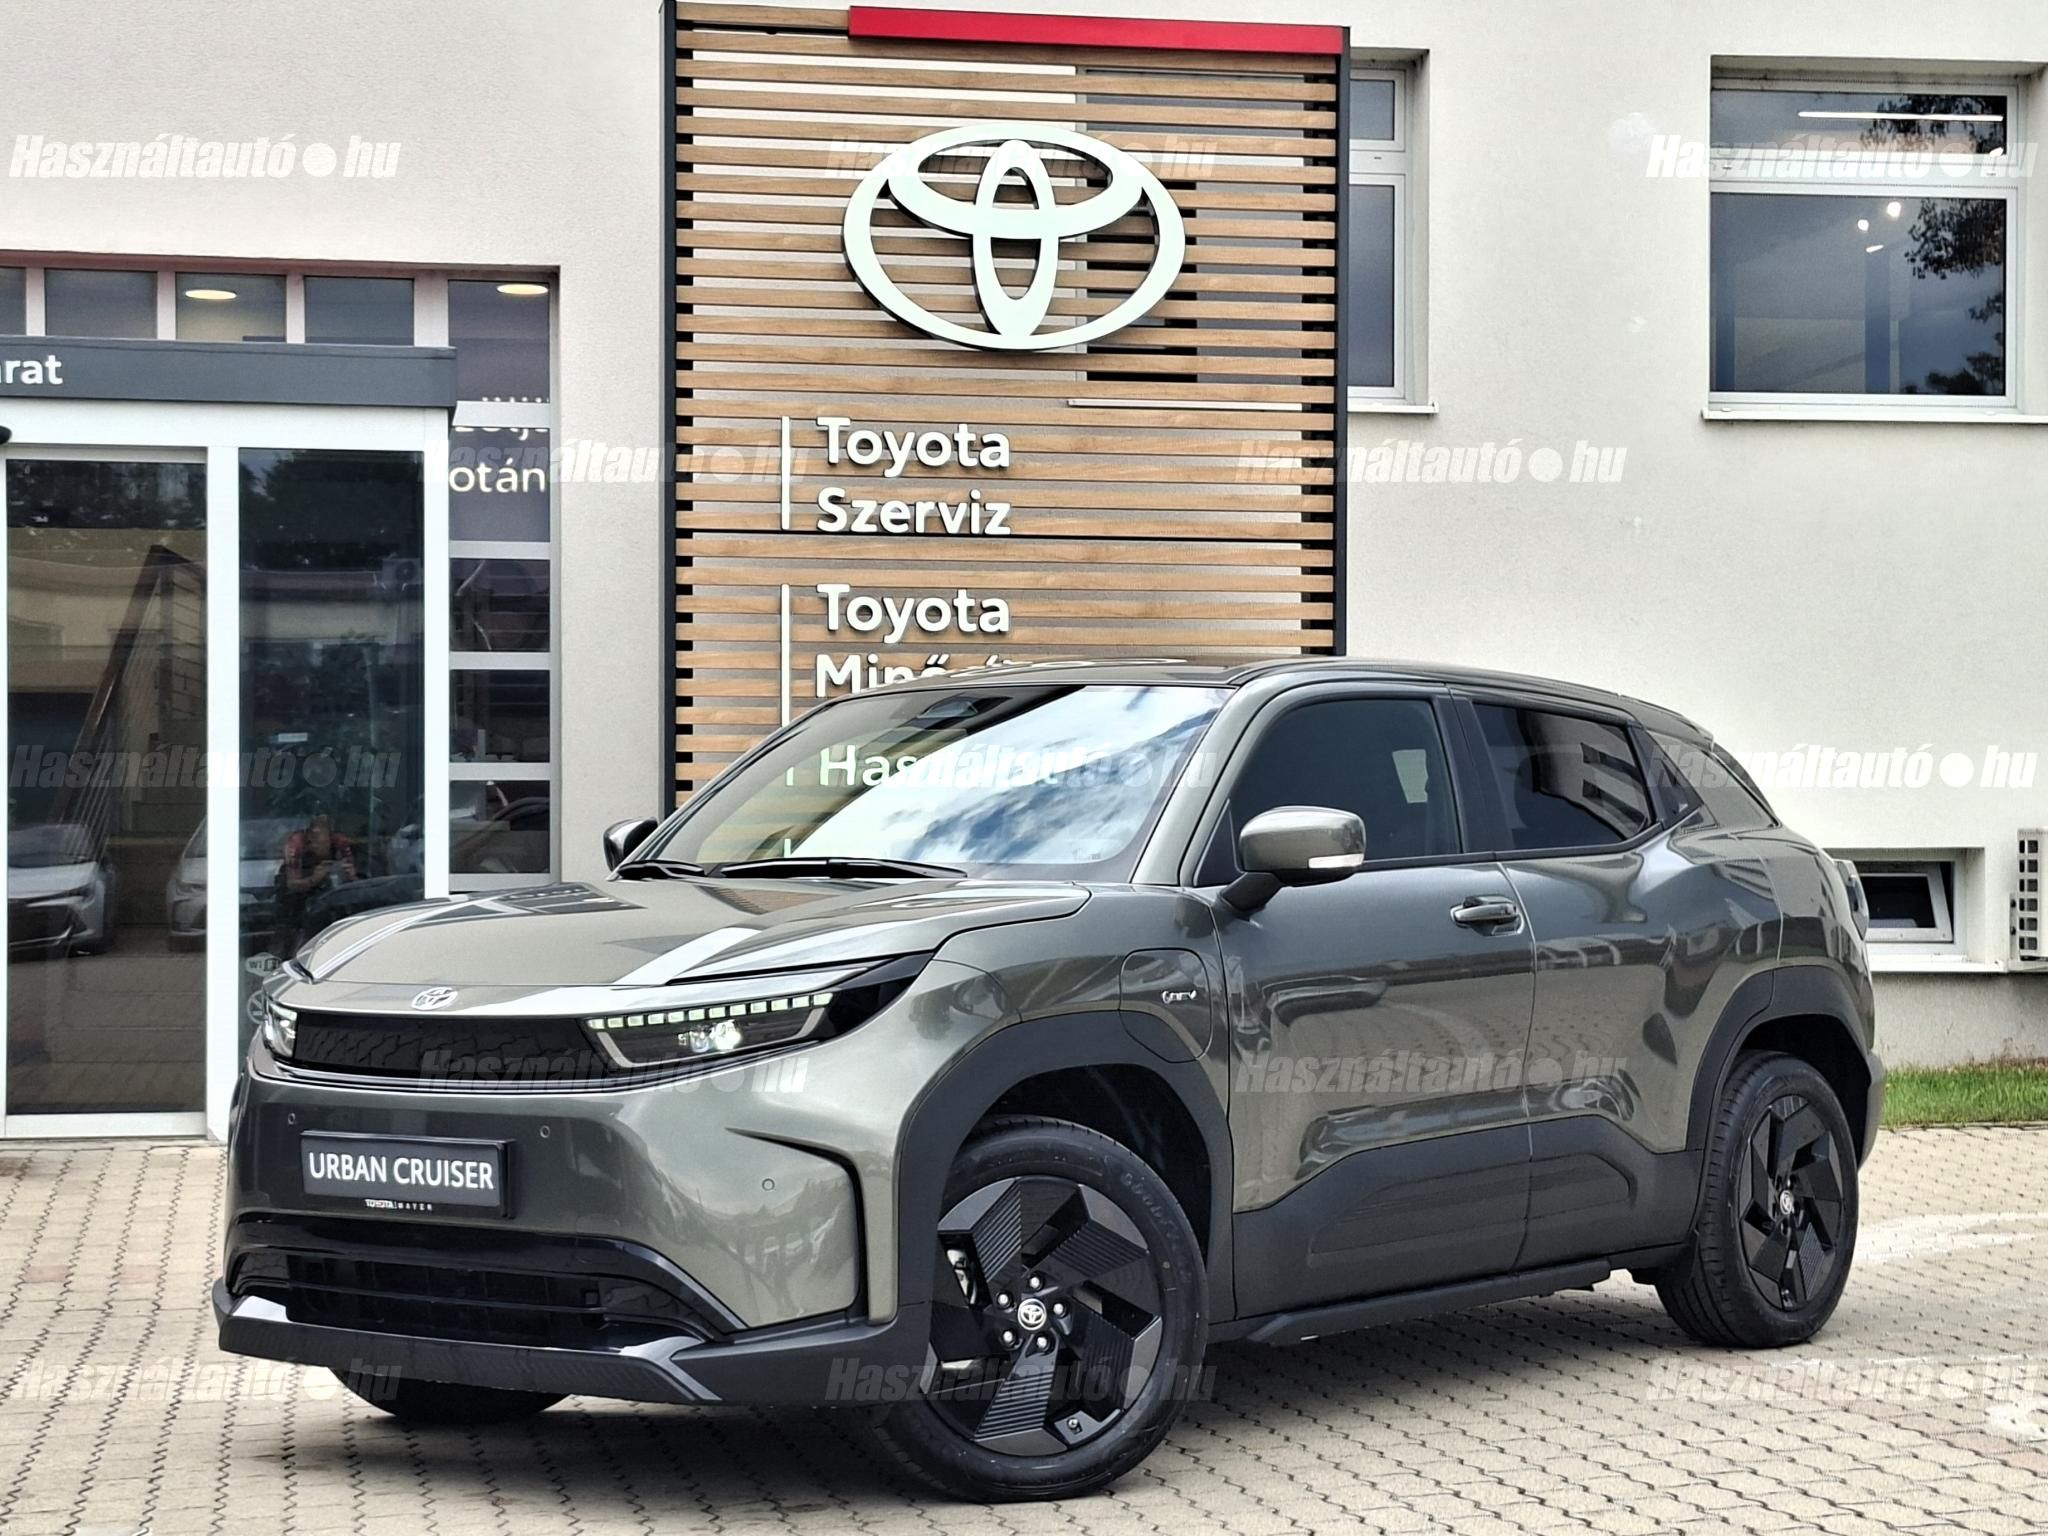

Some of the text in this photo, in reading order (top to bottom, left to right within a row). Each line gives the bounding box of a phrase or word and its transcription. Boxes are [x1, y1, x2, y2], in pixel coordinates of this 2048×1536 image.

[0, 354, 64, 385] rat
[816, 416, 1011, 478] Toyota
[816, 488, 1011, 535] Szerviz
[816, 583, 1011, 643] Toyota
[309, 1152, 495, 1190] URBAN CRUISER
